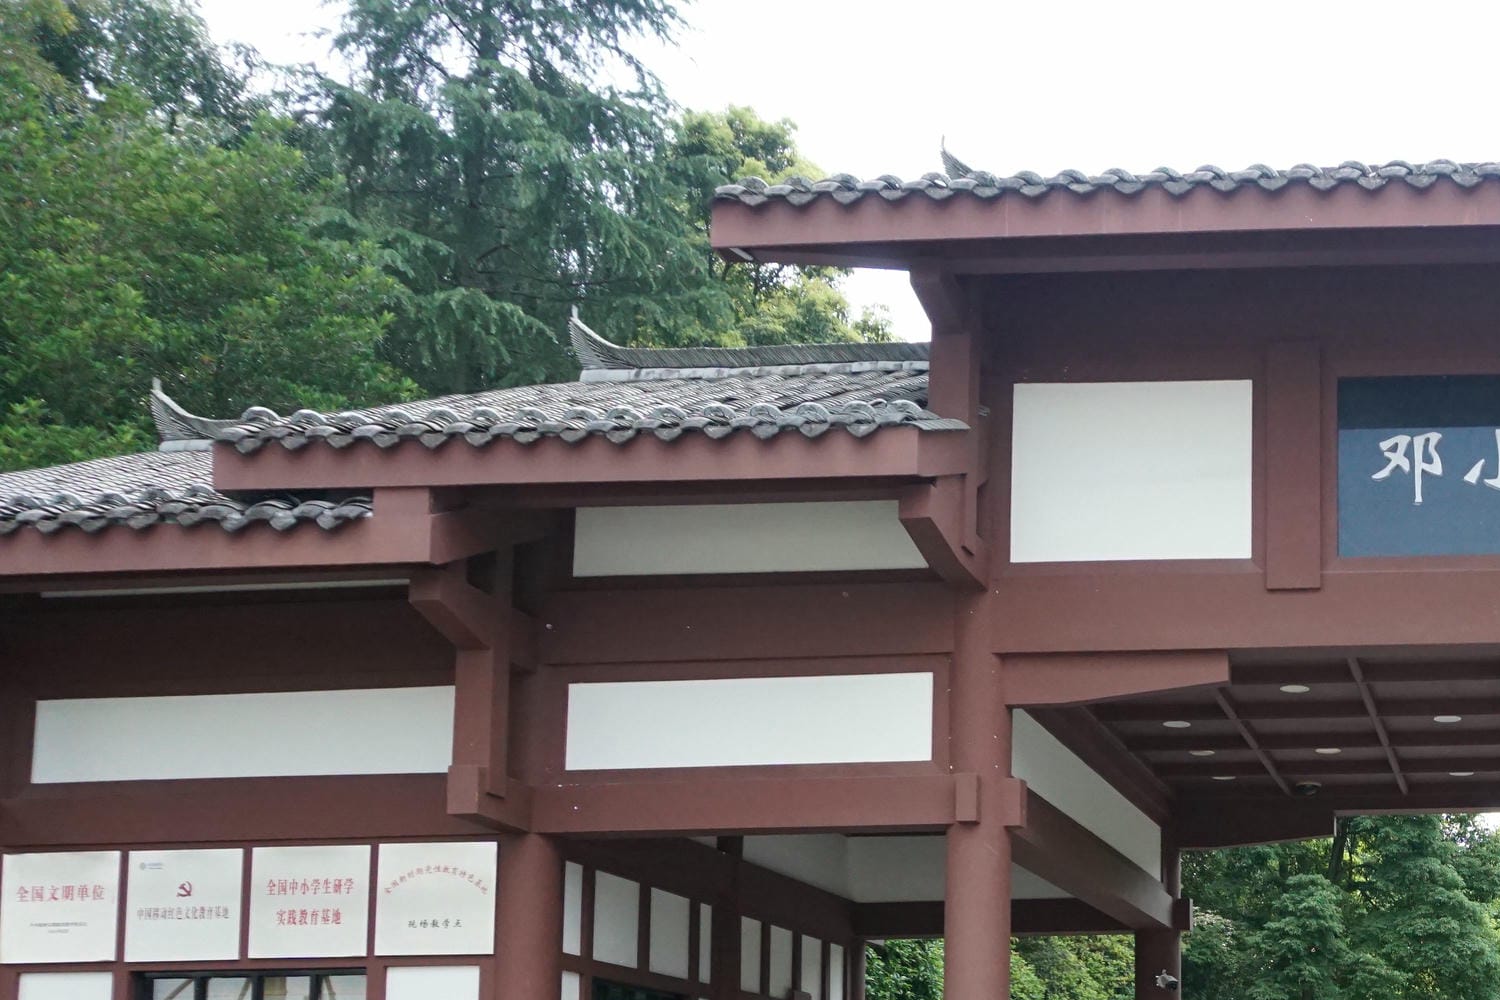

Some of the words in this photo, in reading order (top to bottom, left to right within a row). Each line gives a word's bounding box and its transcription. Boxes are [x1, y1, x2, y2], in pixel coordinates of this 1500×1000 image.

[16, 884, 105, 902] 全国文明单位
[267, 878, 355, 896] 全国中小学生研学
[136, 905, 230, 920] 中国移动红色文化教育基地
[276, 908, 343, 926] 实践教育基地
